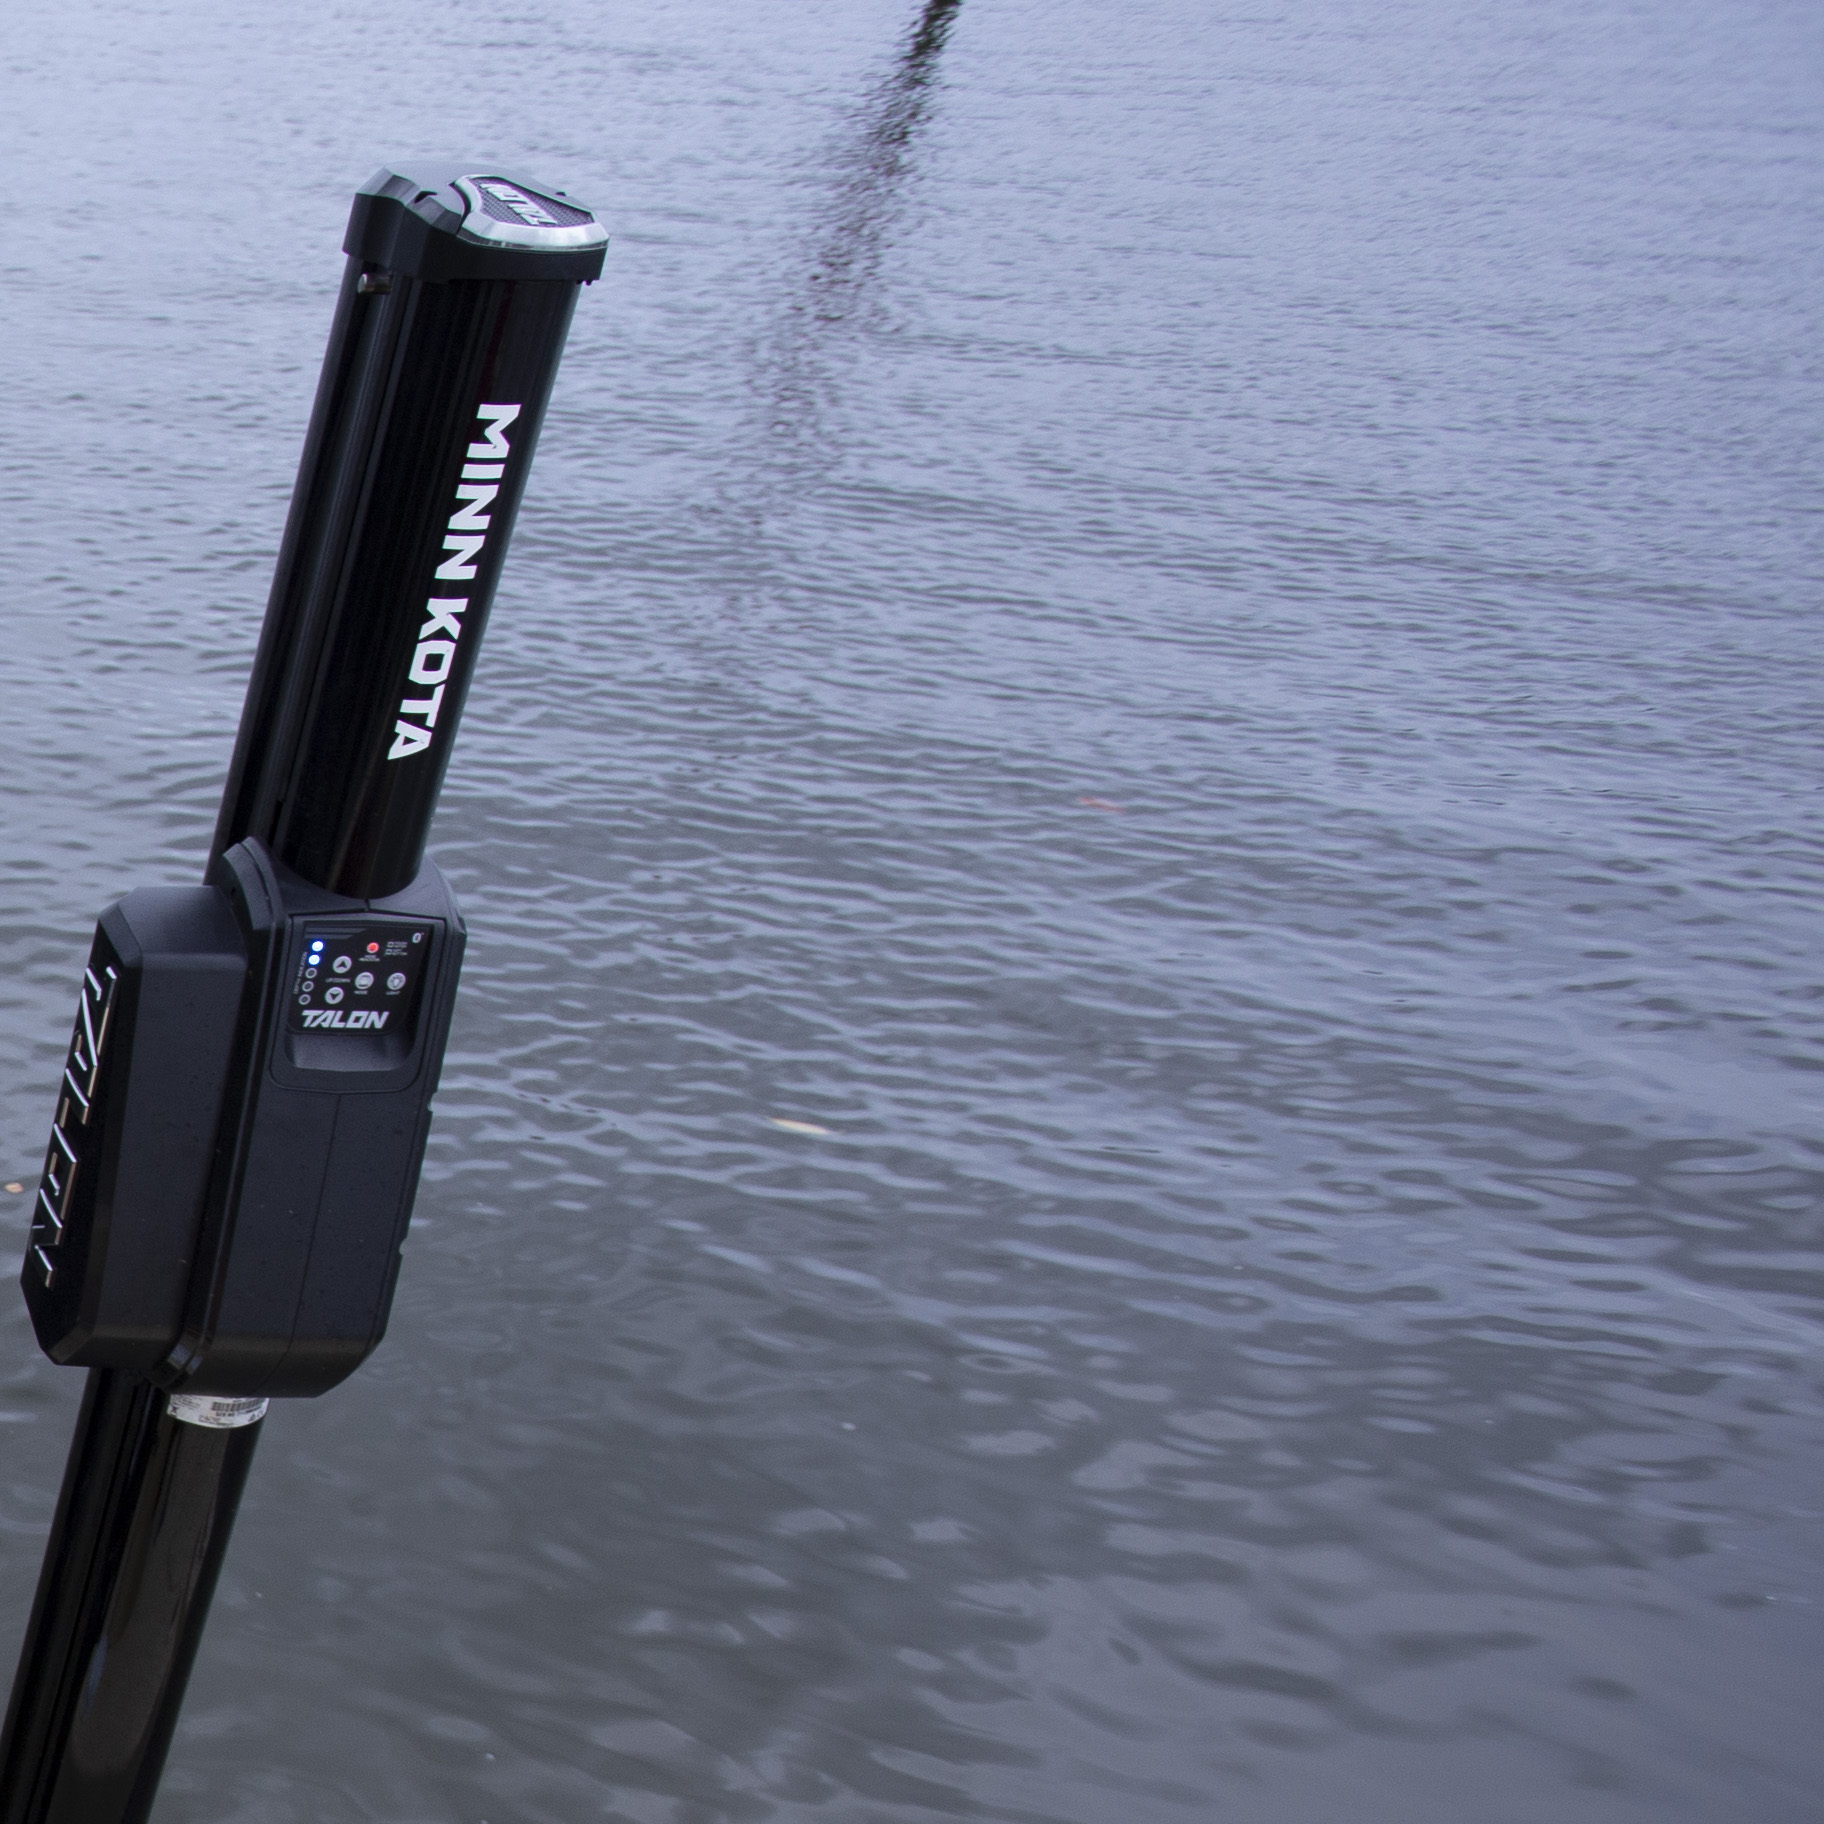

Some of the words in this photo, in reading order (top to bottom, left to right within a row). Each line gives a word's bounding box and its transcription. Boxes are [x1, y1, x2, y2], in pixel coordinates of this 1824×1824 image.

[434, 403, 522, 579] MINN
[387, 598, 469, 761] KOTA
[301, 1009, 390, 1029] TALON
